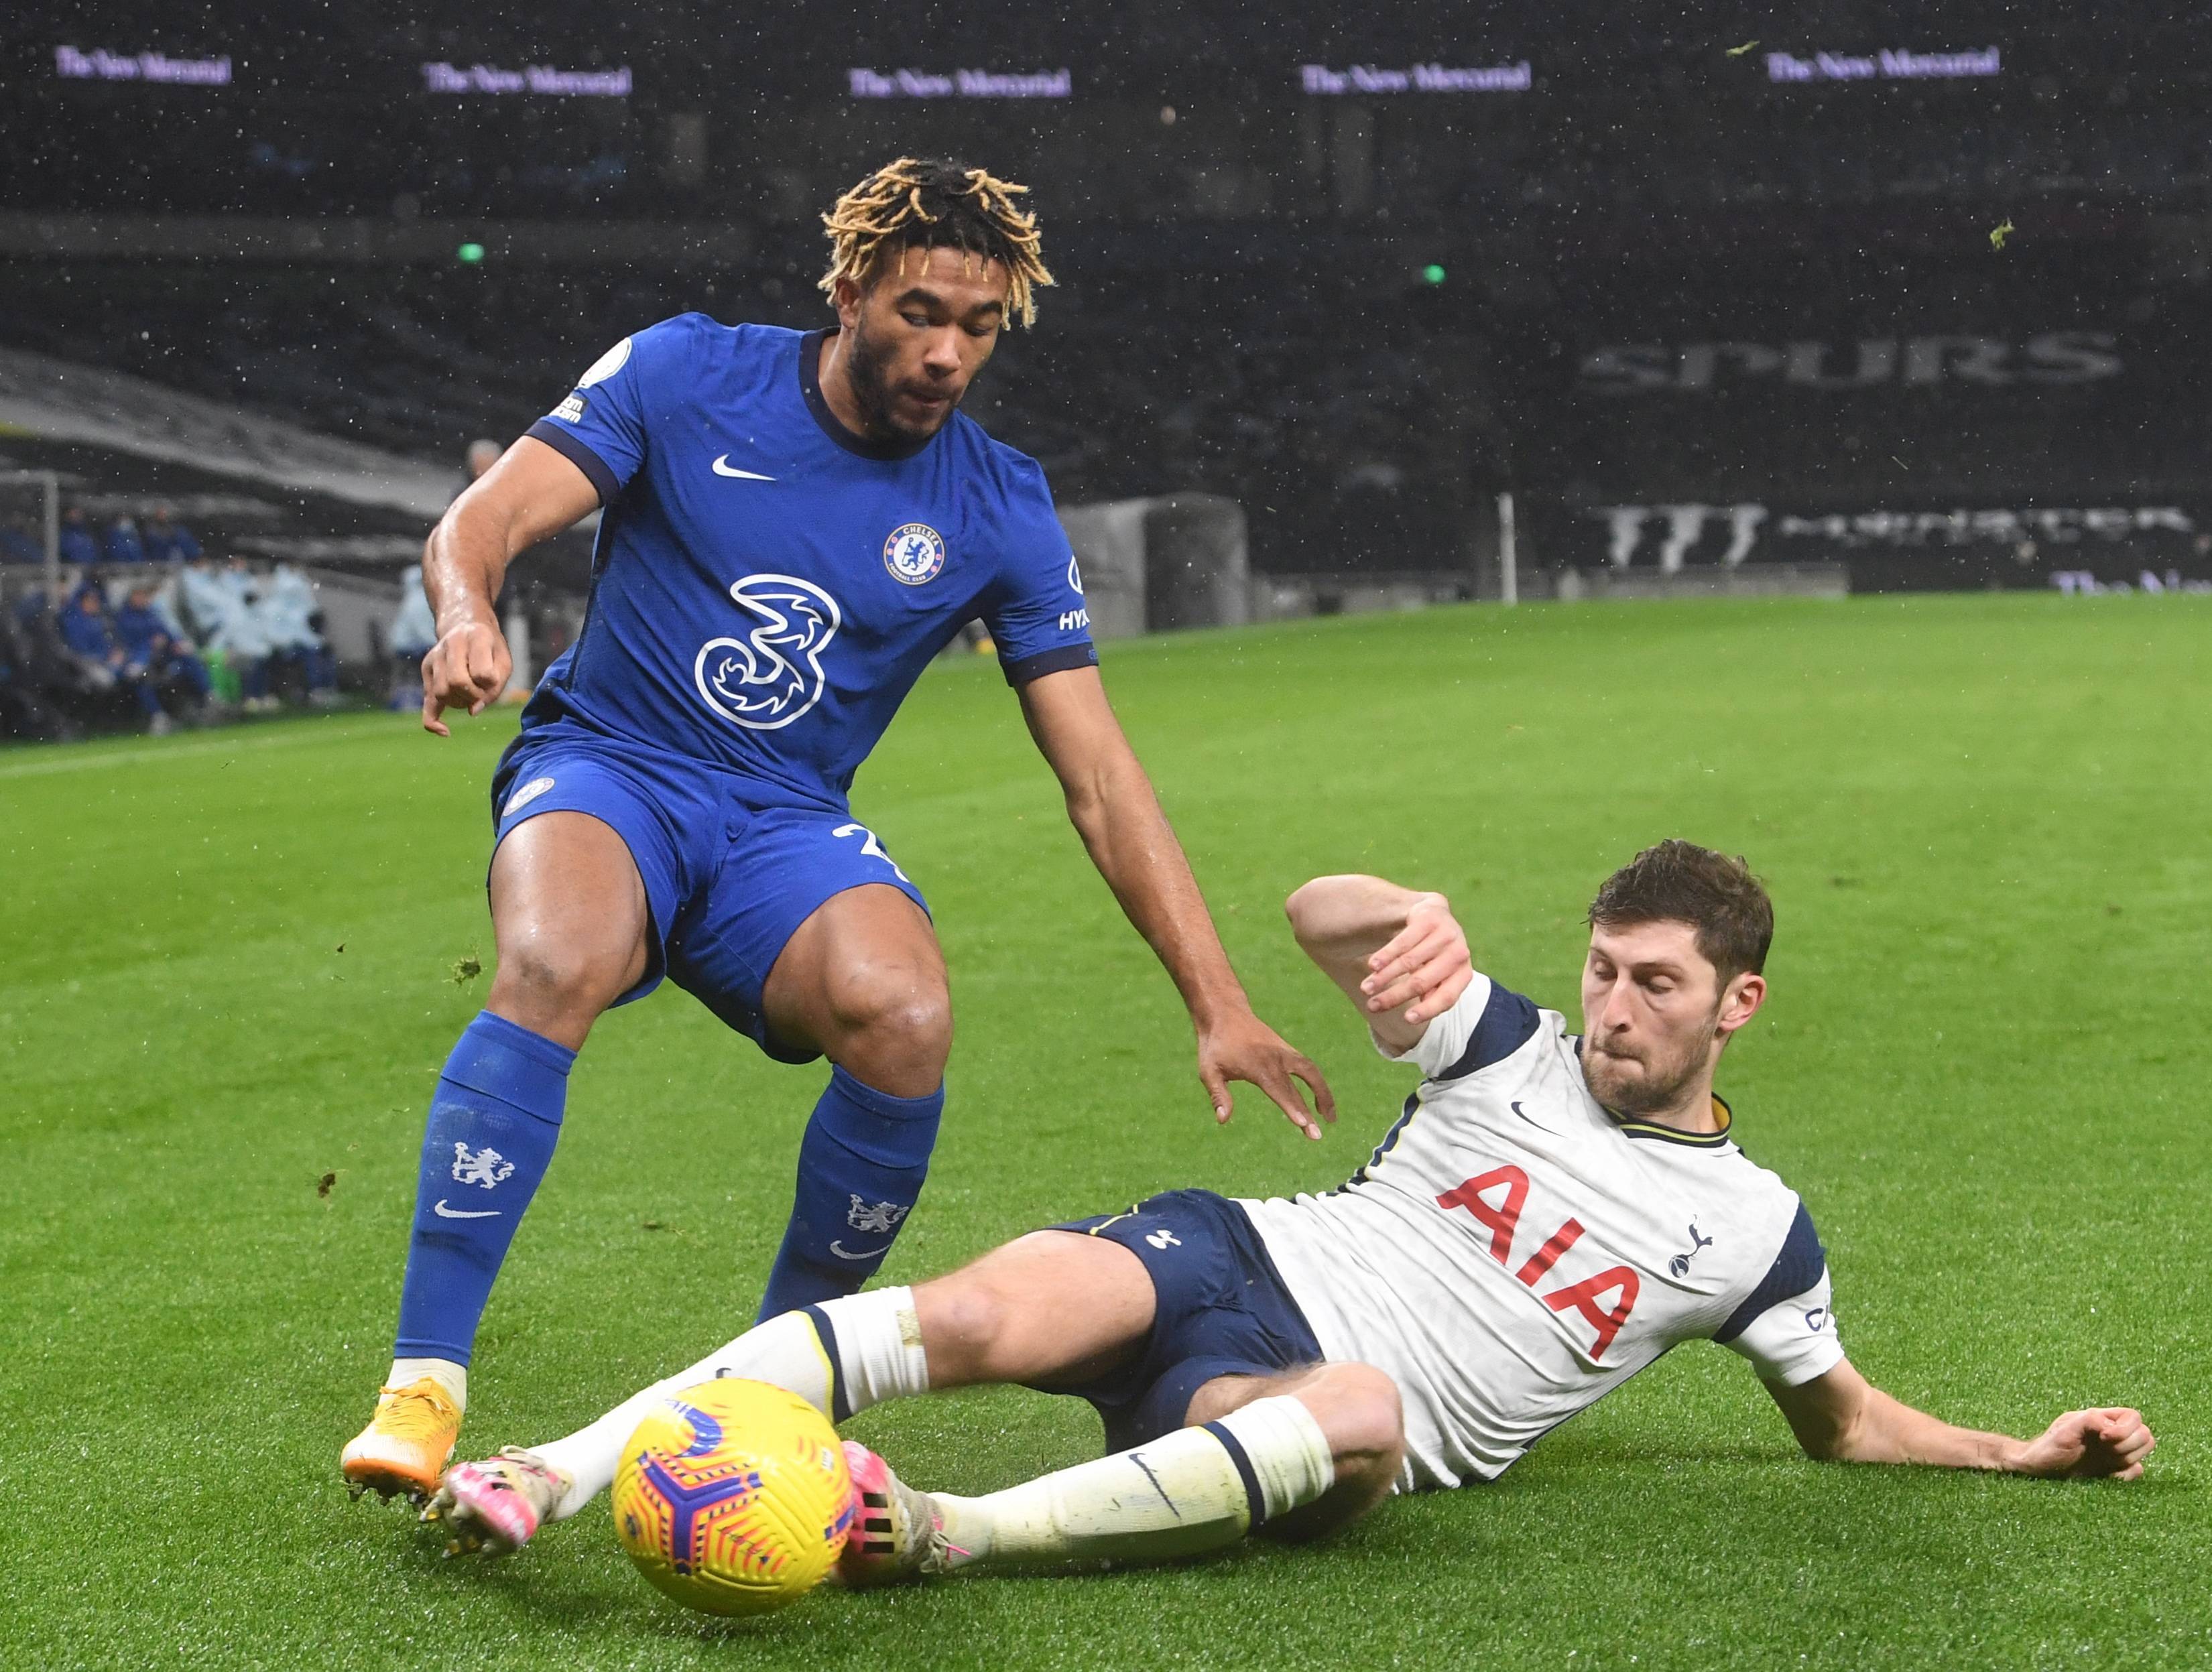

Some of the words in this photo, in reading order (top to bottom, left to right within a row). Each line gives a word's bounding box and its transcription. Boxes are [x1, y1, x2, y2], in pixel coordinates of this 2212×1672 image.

[902, 526, 940, 547] CHELSEA
[694, 574, 841, 730] 3
[1434, 1164, 1641, 1363] AIA
